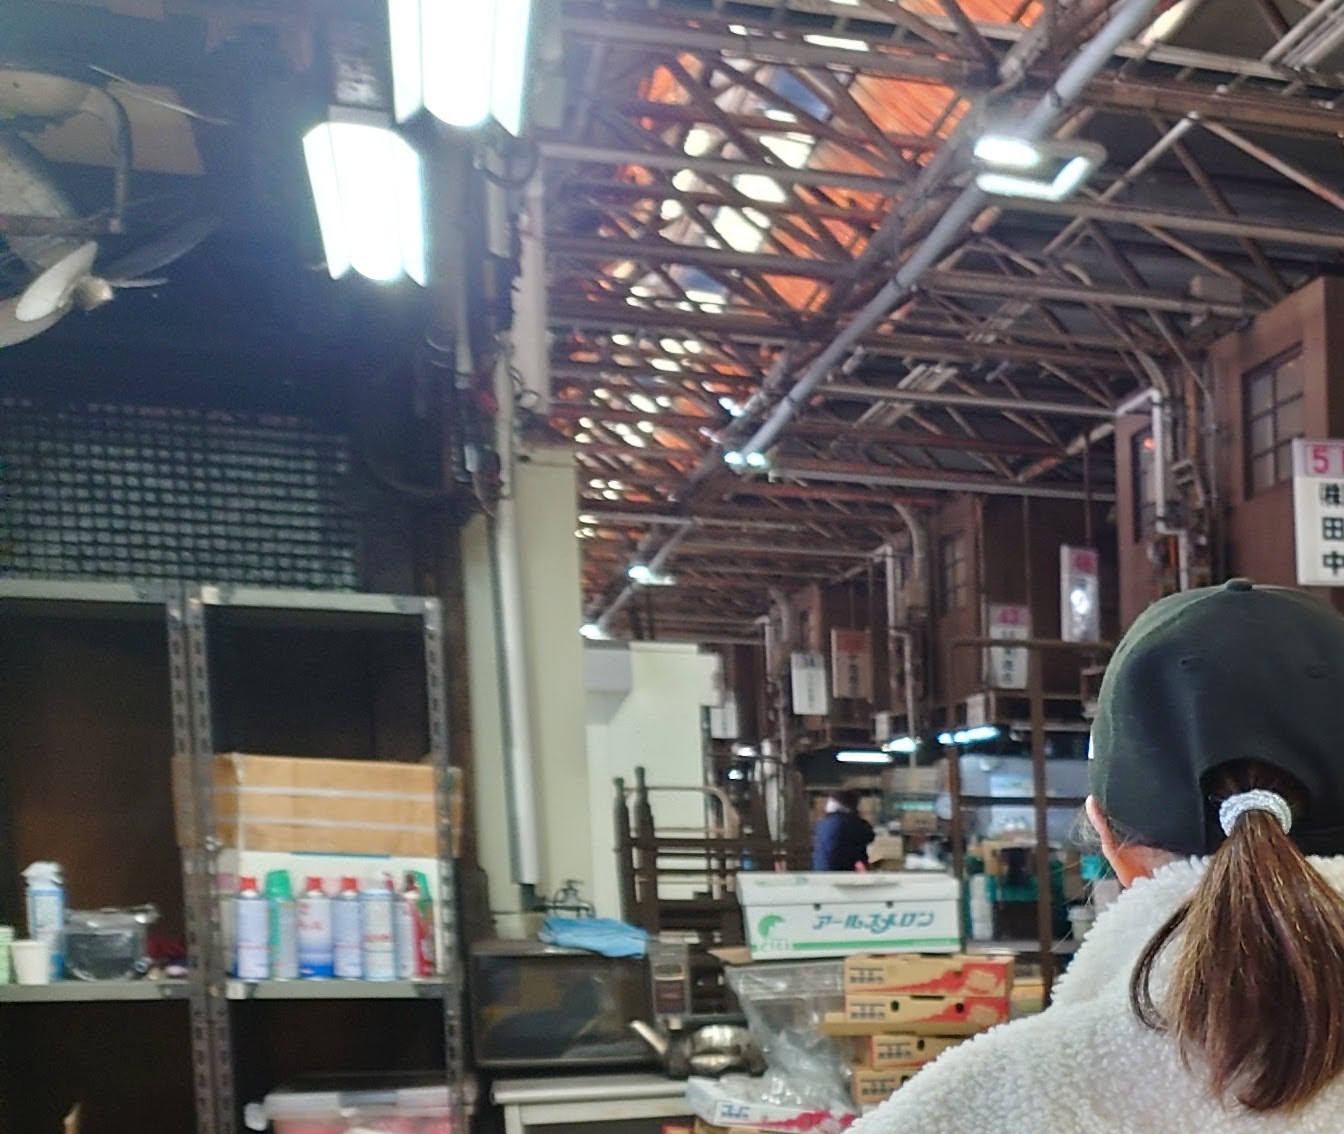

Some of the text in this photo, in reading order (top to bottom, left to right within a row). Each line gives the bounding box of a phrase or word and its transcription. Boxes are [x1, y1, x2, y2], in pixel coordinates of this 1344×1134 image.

[811, 911, 936, 934] アールスメロン
